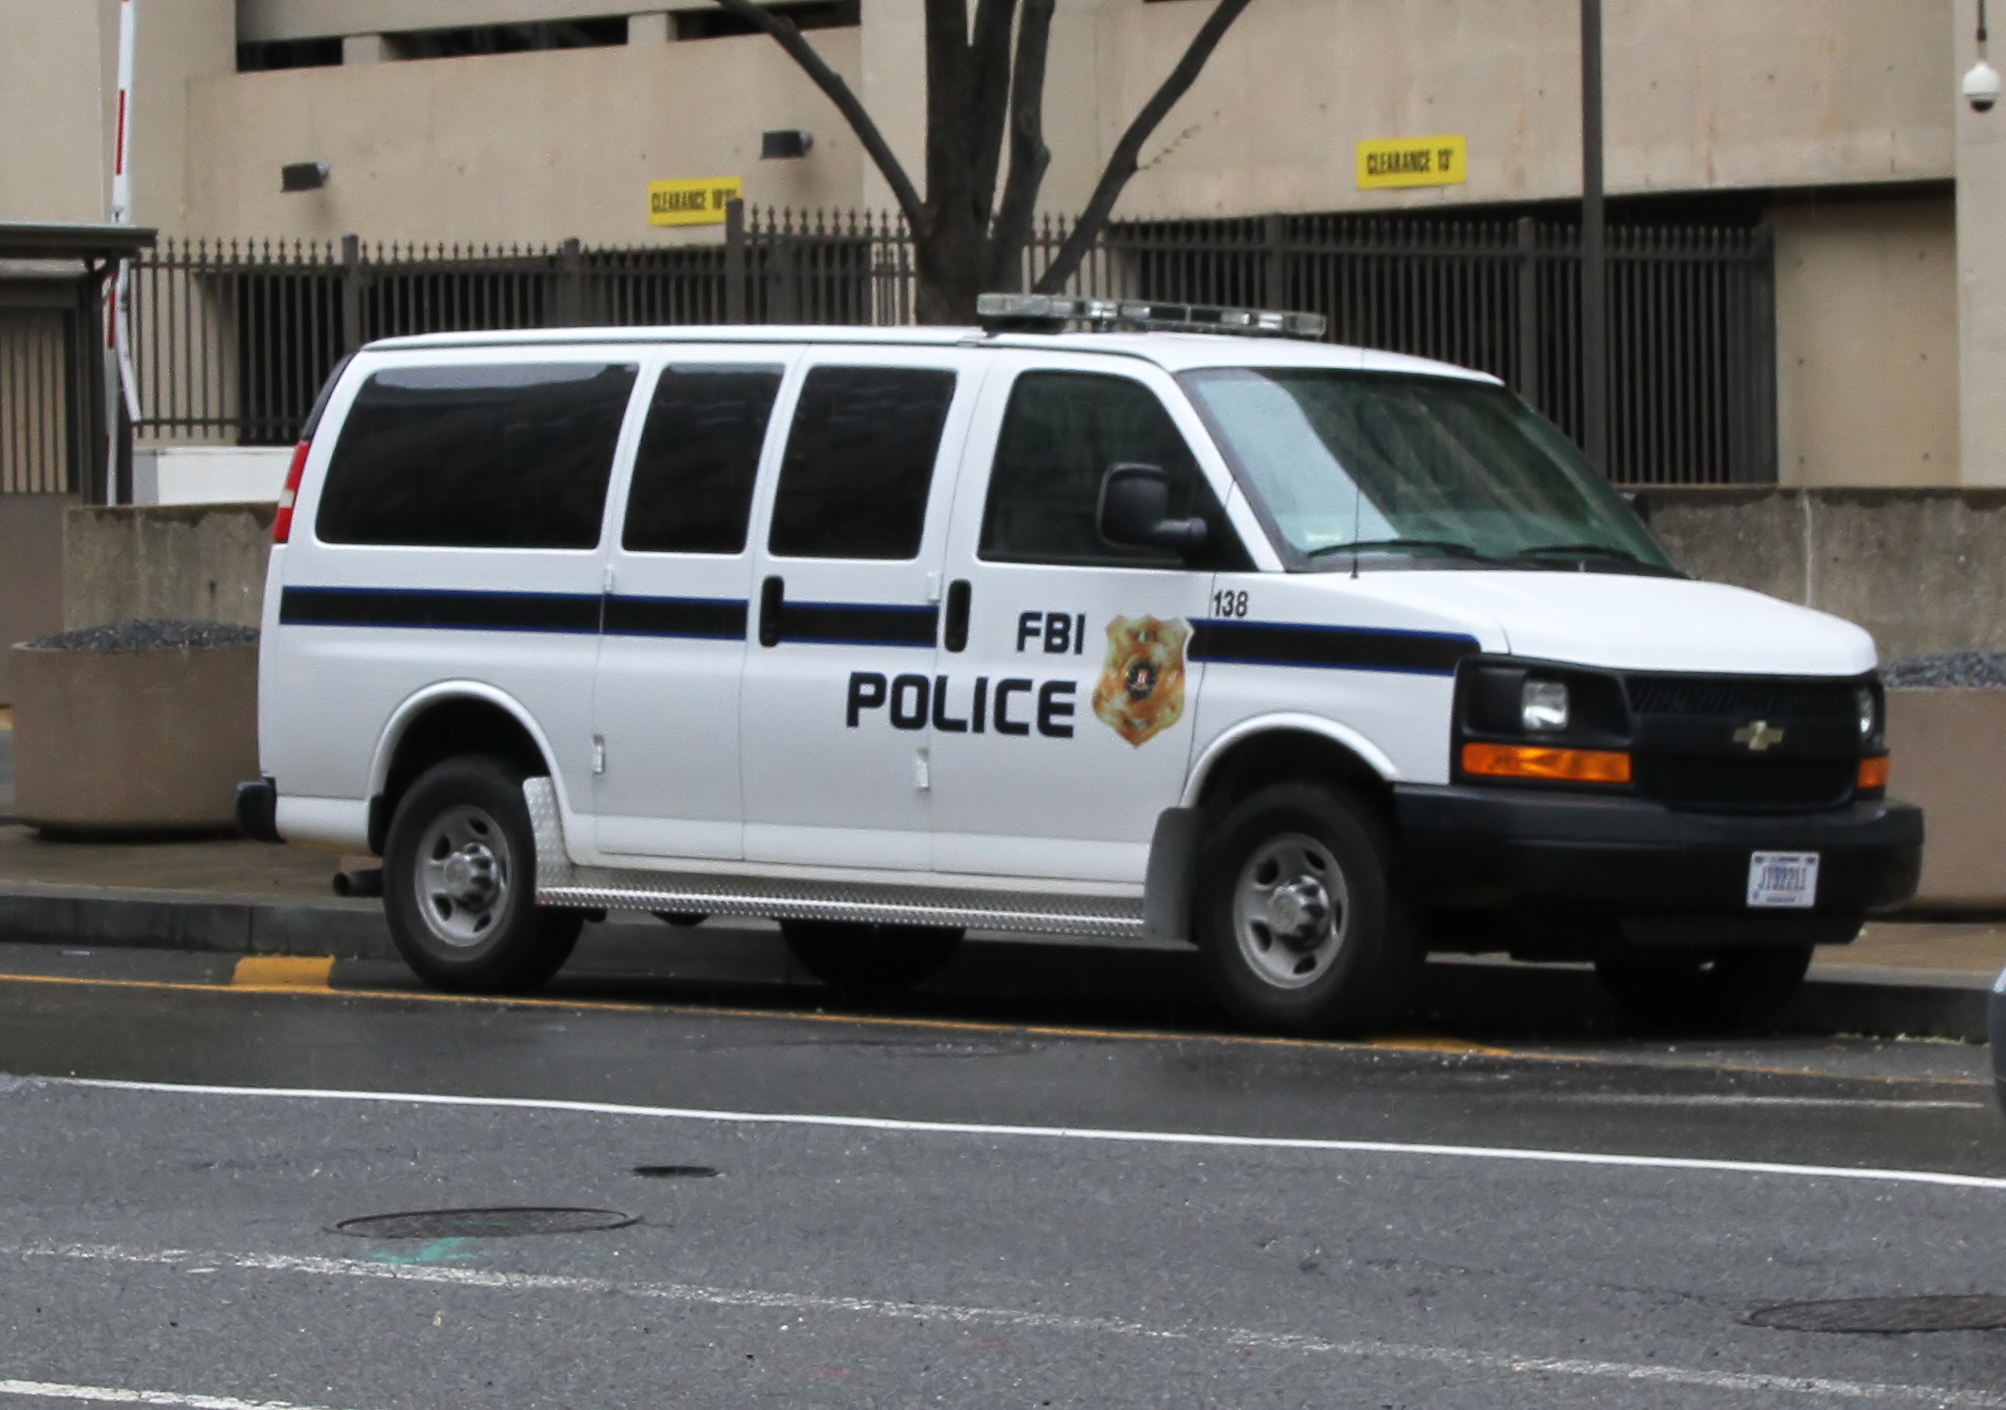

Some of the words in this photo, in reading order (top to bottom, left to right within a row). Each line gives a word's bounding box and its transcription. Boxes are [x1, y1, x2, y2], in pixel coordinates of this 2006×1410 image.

[1367, 149, 1430, 175] CLEARANCE
[652, 189, 706, 213] CLEARANCE
[1213, 589, 1248, 617] 138
[1016, 611, 1086, 655] FBI
[846, 671, 1077, 738] POLICE
